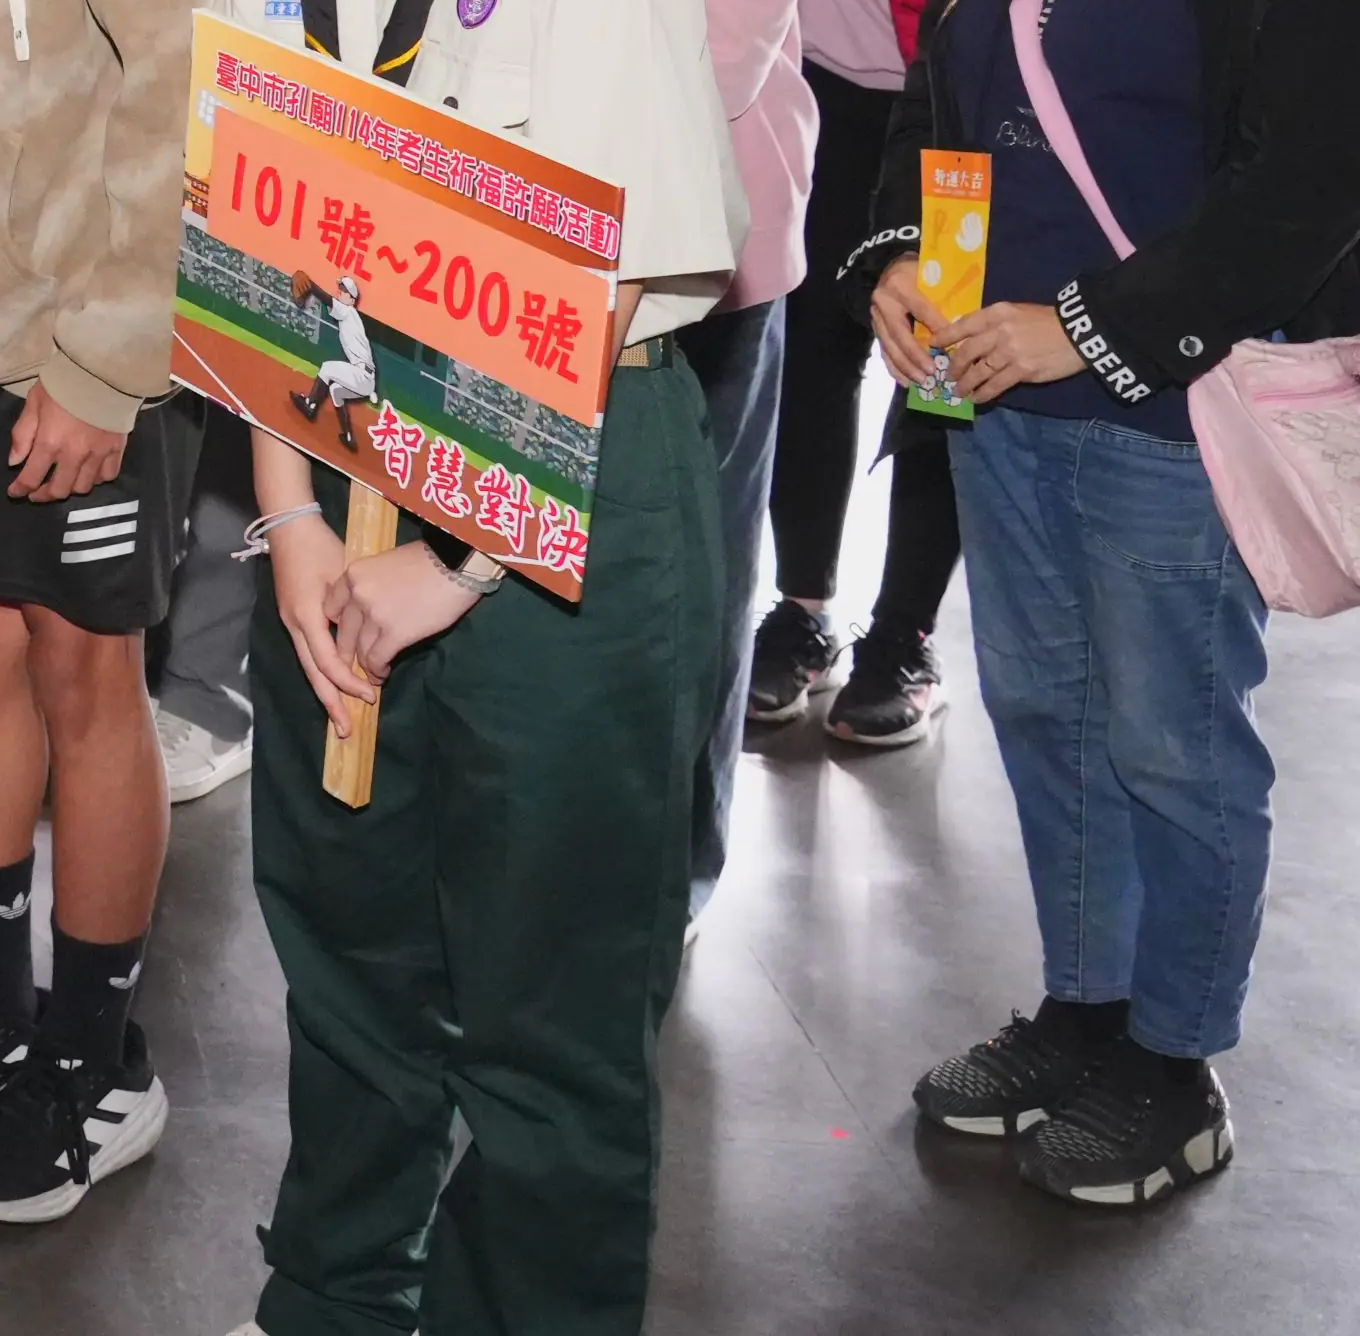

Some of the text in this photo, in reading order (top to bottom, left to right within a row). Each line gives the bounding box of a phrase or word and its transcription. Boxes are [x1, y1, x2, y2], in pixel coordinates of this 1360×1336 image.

[216, 51, 620, 260] 臺中市孔廟114年考生祈福許願活動
[231, 152, 583, 385] 101號~200號
[368, 400, 589, 583] 智慧對決
